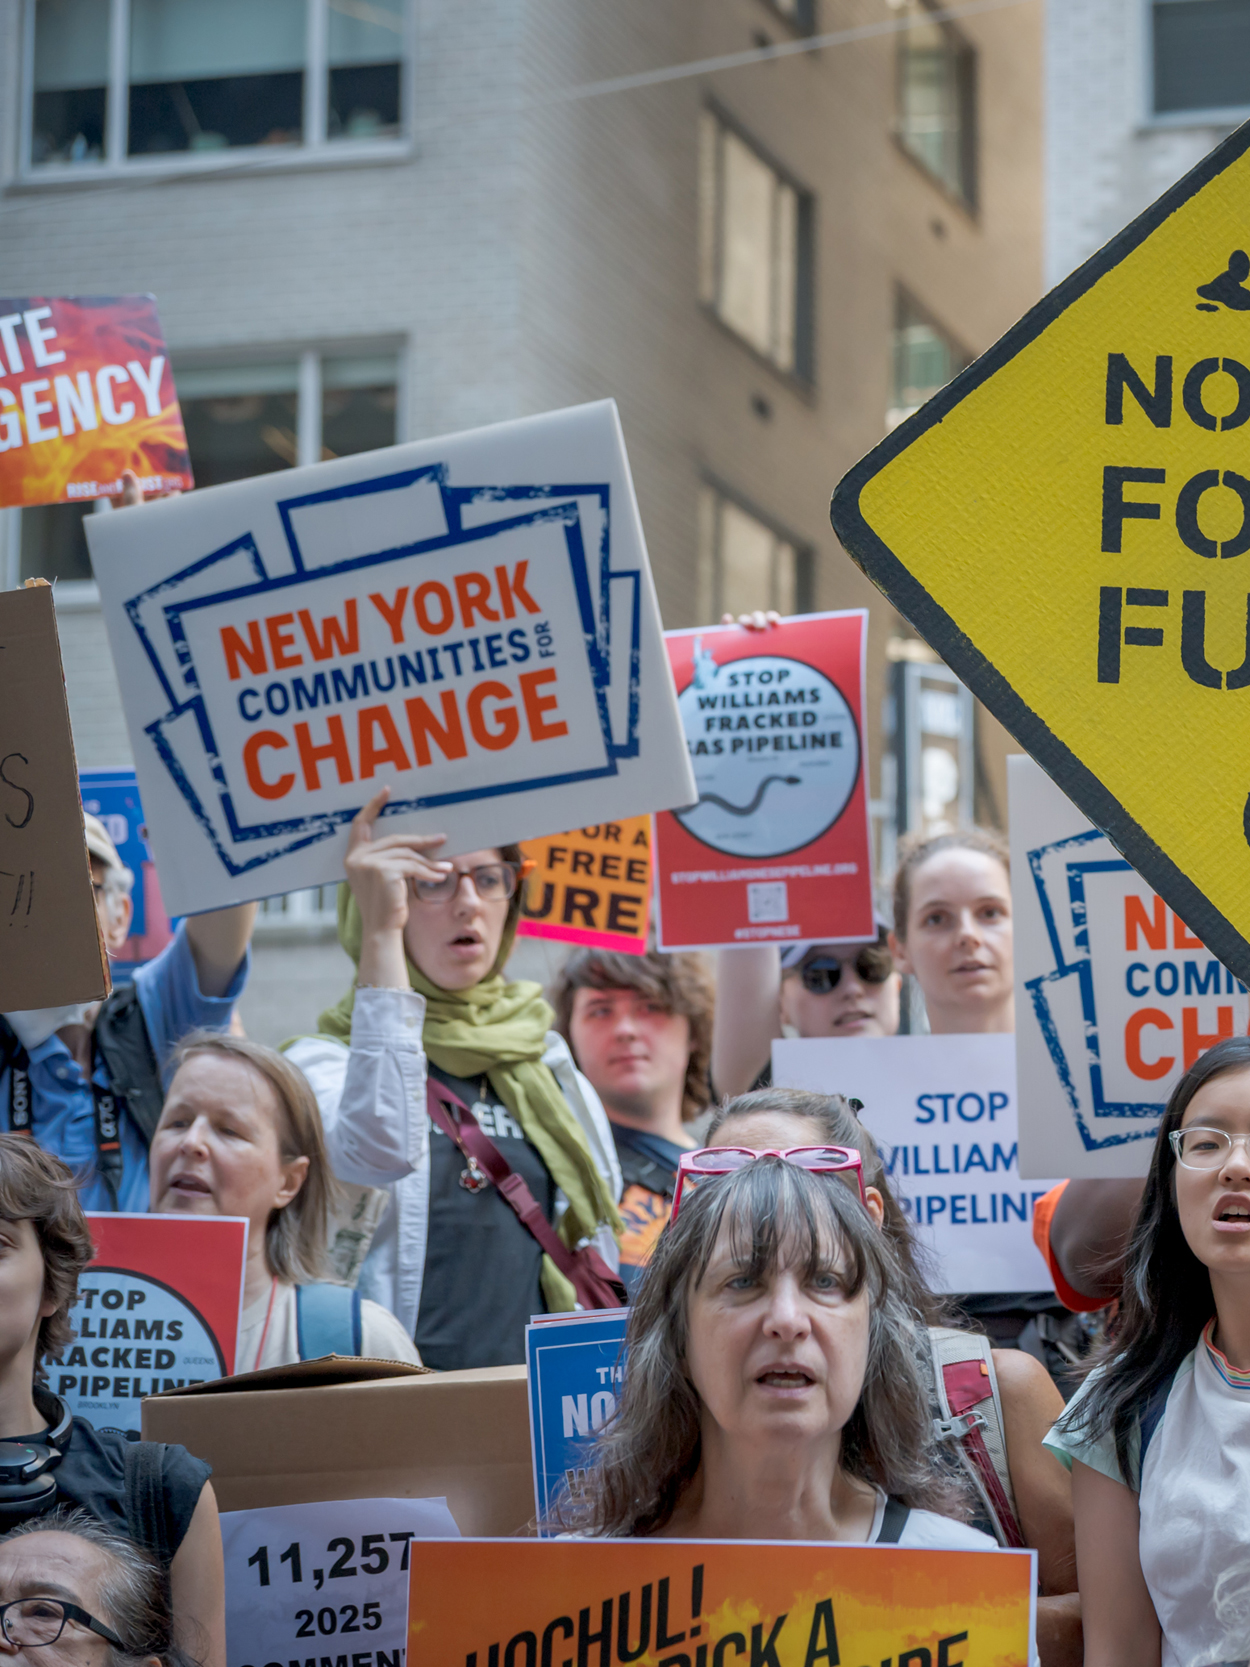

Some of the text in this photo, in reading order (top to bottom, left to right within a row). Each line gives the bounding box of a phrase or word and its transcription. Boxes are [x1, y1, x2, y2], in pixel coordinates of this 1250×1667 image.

[219, 559, 542, 681] NEW YORK
[237, 620, 556, 722] COMMUNITIES FOR
[727, 669, 791, 687] STOP
[697, 688, 820, 711] WILLIAMS
[242, 667, 569, 801] CHANGE
[705, 711, 817, 732] FRACKED
[686, 731, 842, 756] AS PIPELINE
[632, 829, 649, 848] A
[547, 846, 649, 884] FREE
[13, 1068, 28, 1126] SONY
[915, 1091, 1009, 1124] STOP
[248, 1532, 415, 1591] 11,257
[295, 1602, 382, 1638] 2025
[803, 1598, 842, 1667] A
